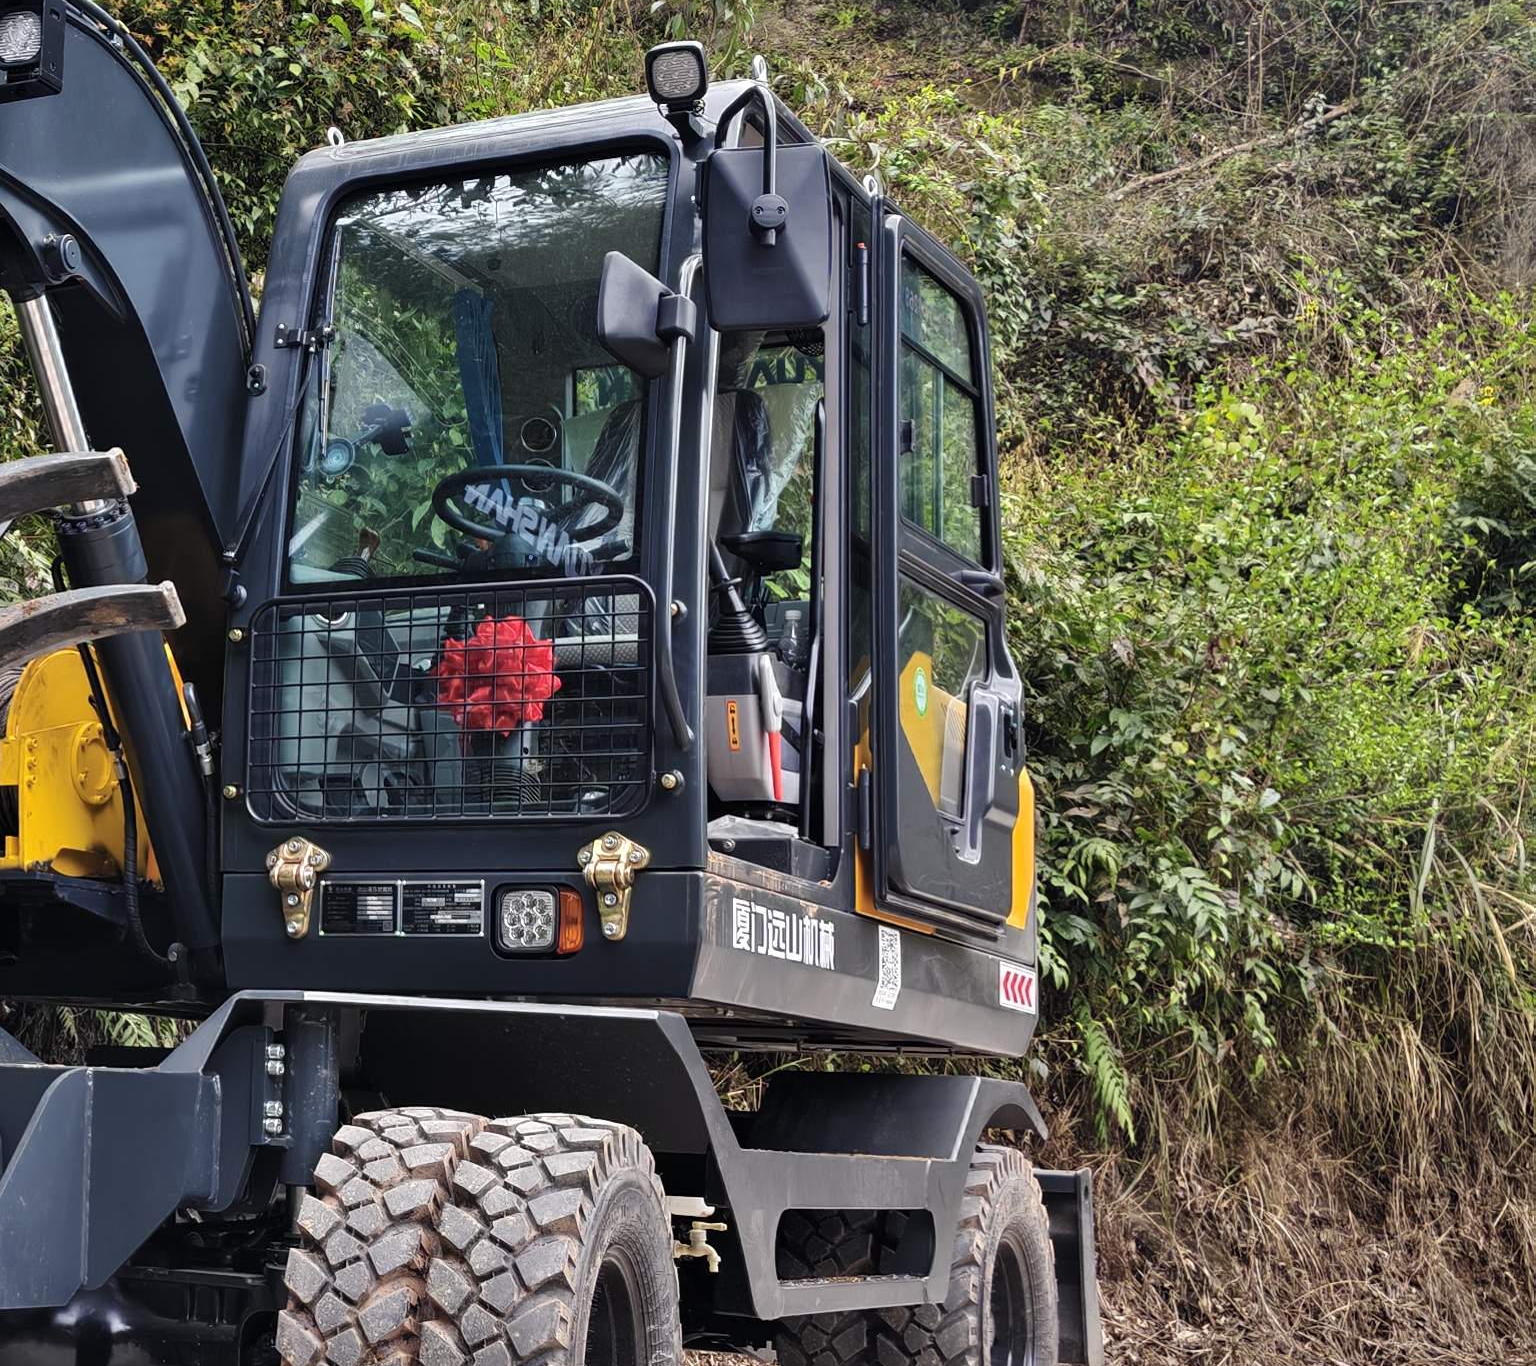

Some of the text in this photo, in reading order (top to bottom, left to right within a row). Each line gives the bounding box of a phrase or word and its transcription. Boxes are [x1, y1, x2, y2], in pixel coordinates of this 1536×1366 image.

[732, 897, 835, 970] 厦门远山机械
